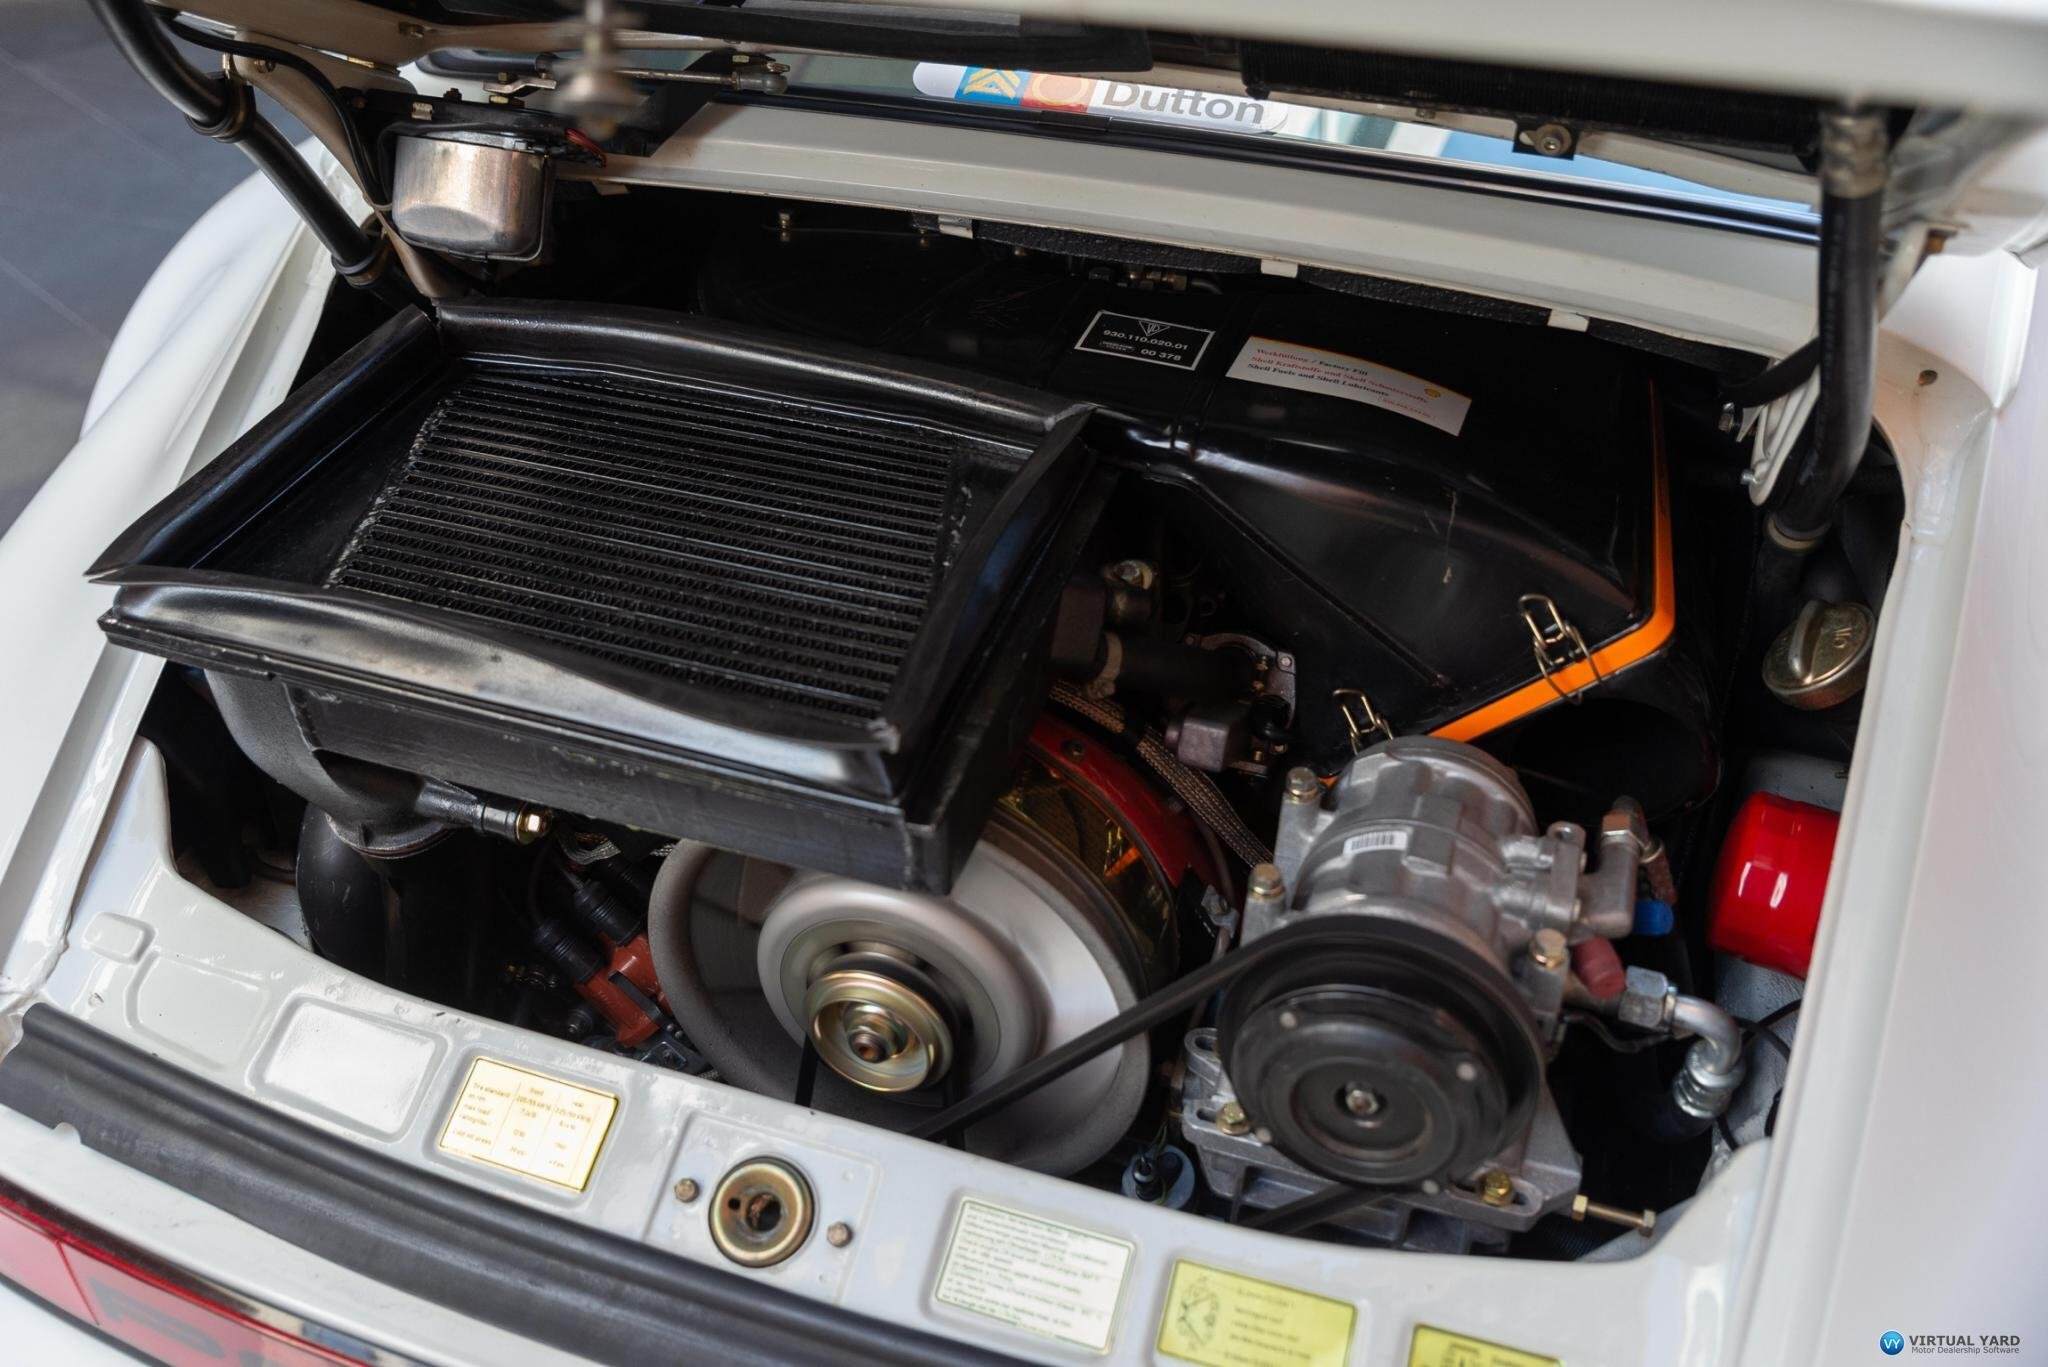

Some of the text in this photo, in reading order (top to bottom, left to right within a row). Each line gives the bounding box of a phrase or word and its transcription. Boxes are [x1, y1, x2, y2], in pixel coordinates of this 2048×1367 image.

[1102, 80, 1266, 125] Dutton
[1251, 356, 1274, 365] Shell
[1247, 363, 1271, 372] Shell
[1297, 372, 1315, 380] and
[1316, 375, 1340, 385] Shell
